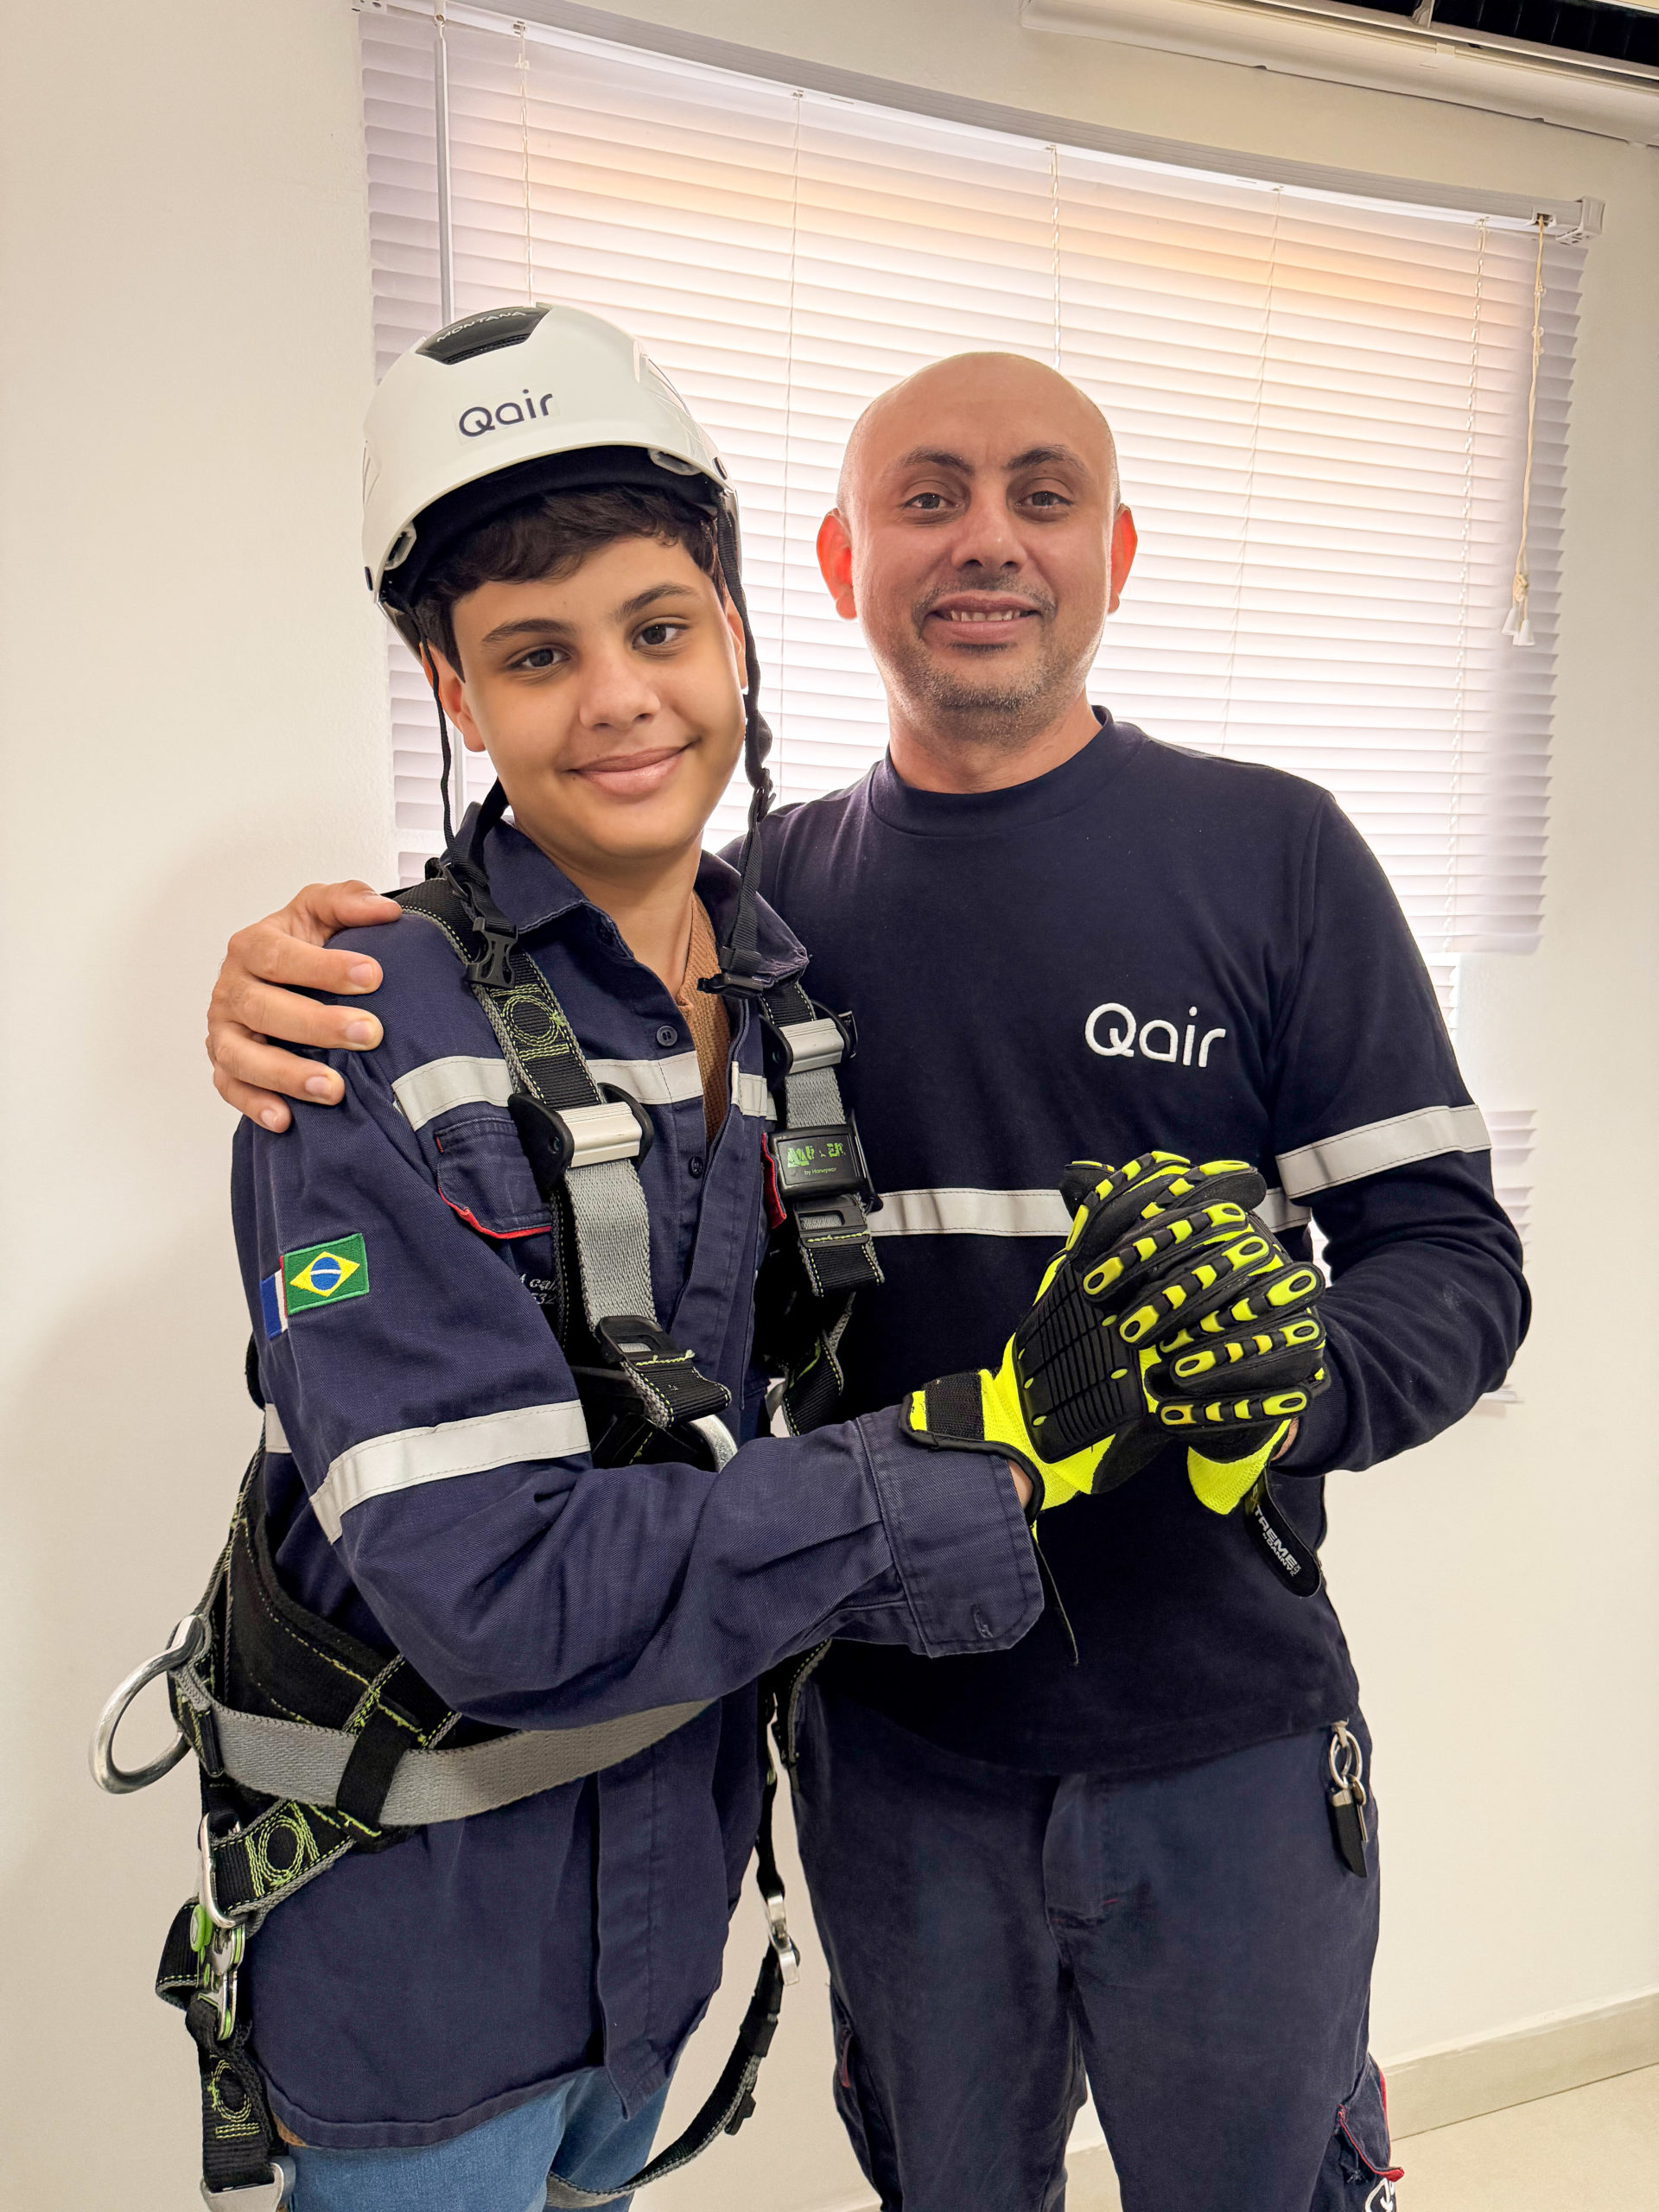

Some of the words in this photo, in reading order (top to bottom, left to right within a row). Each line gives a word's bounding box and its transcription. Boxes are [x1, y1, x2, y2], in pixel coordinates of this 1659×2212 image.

[436, 310, 526, 343] MONTANA
[459, 388, 553, 437] Qair
[1084, 1002, 1226, 1067] Qair
[1267, 1539, 1293, 1571] DANNY
